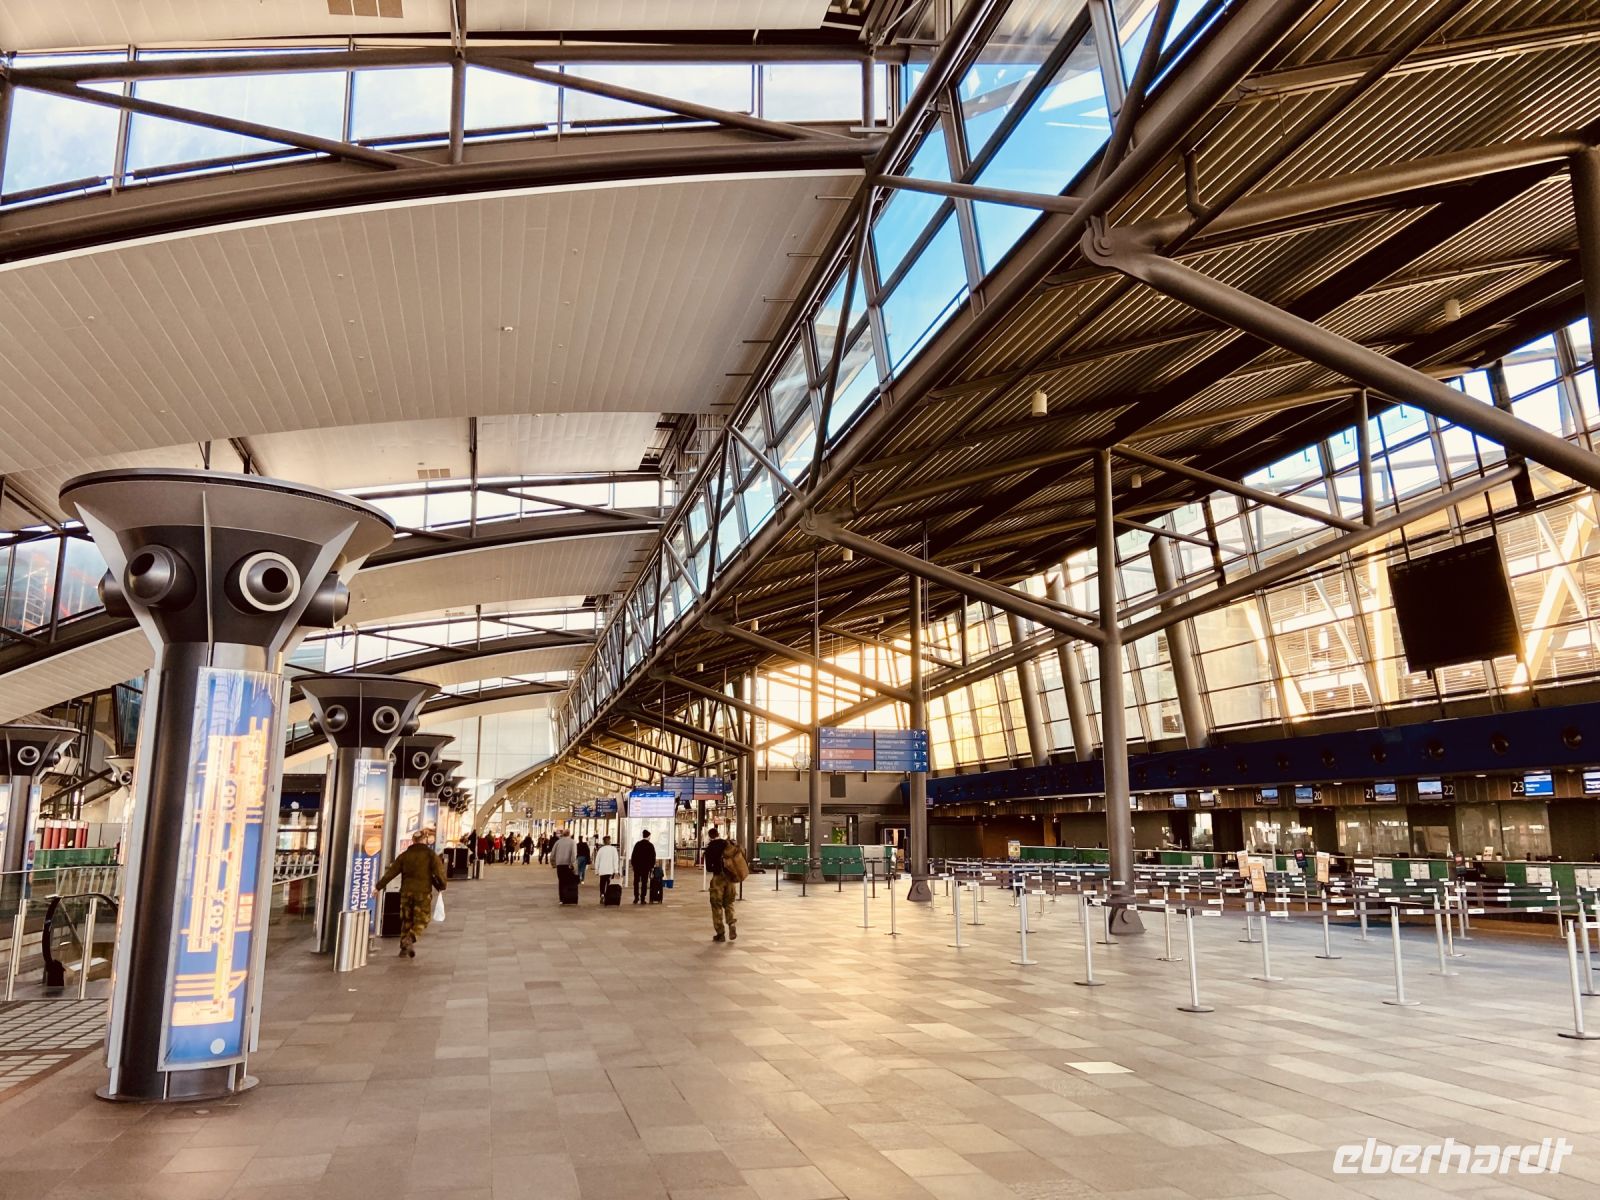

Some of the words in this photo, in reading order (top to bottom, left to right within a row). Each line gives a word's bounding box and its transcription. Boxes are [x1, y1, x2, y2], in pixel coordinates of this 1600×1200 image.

[1443, 785, 1454, 796] 22
[1512, 781, 1524, 792] 23
[1313, 791, 1322, 800] 20
[1366, 788, 1374, 799] 21
[351, 858, 363, 911] ASZINATION
[360, 857, 371, 909] FLUGHAFEN
